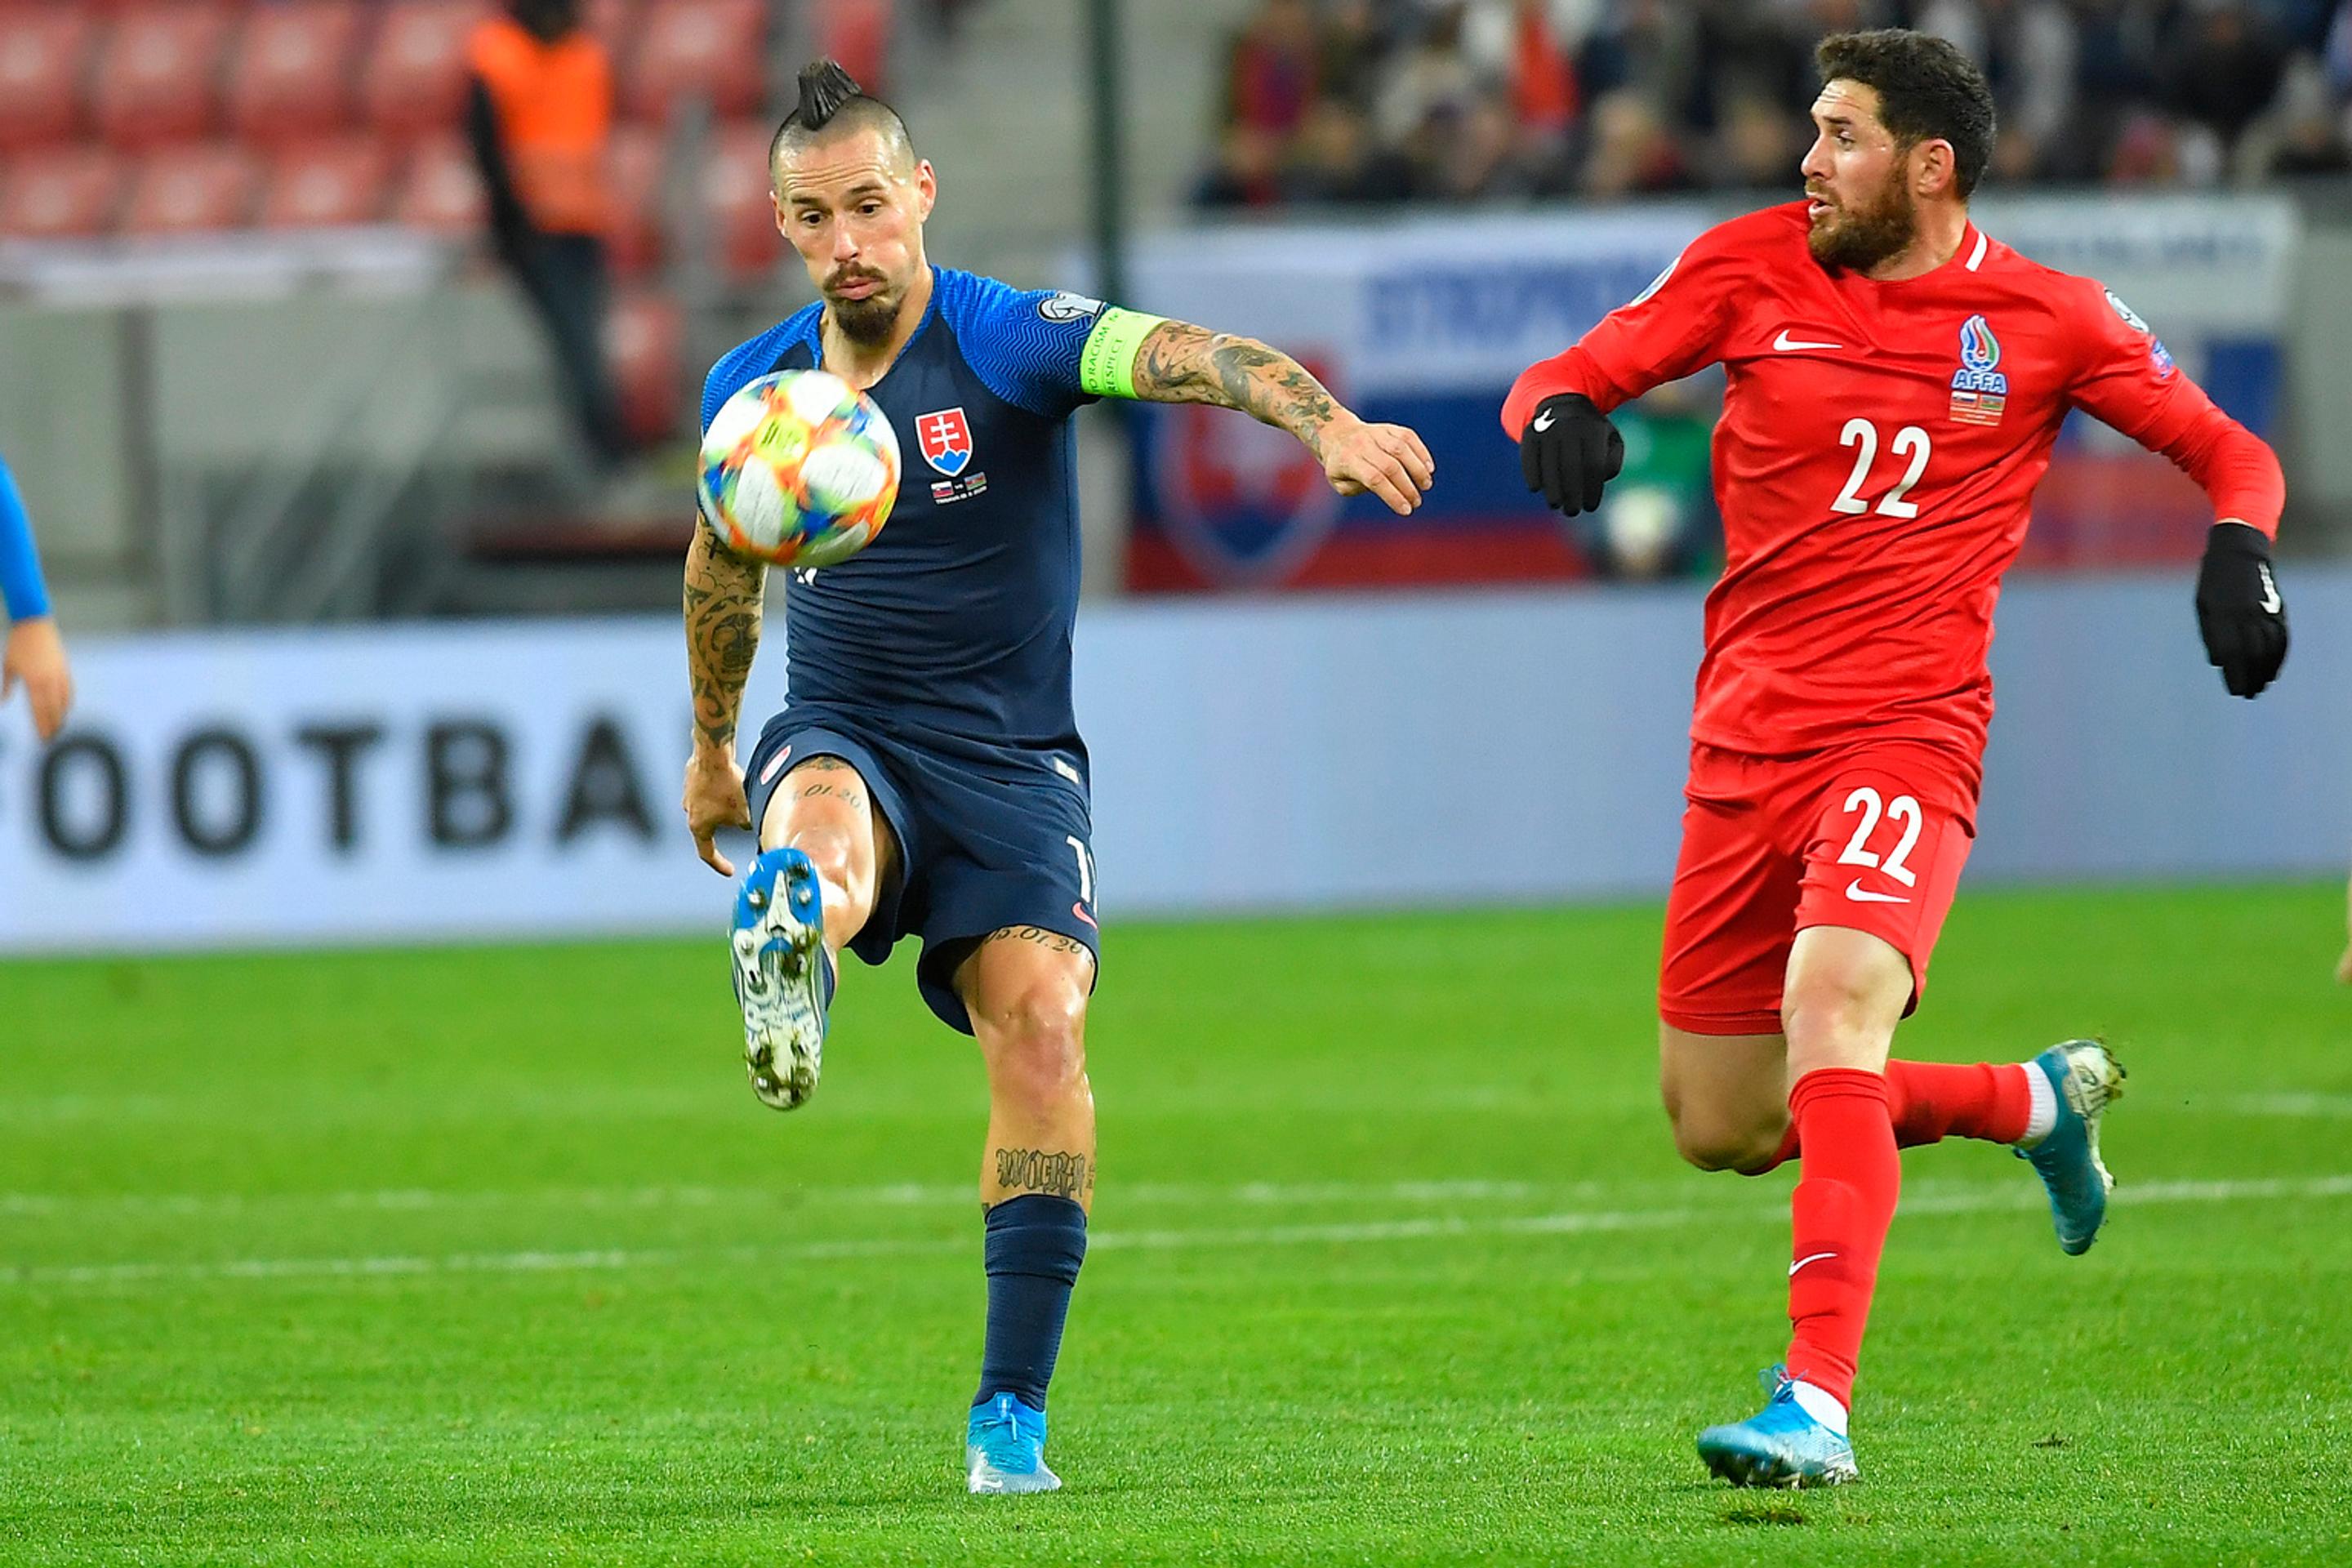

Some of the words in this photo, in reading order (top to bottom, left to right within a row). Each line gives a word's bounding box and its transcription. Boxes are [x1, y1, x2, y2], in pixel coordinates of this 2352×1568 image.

[1087, 326, 1111, 377] RACISM
[1105, 338, 1124, 394] RESPECT
[1953, 370, 2007, 394] AFFA
[1830, 417, 1932, 519] 22
[1837, 786, 1923, 888] 22
